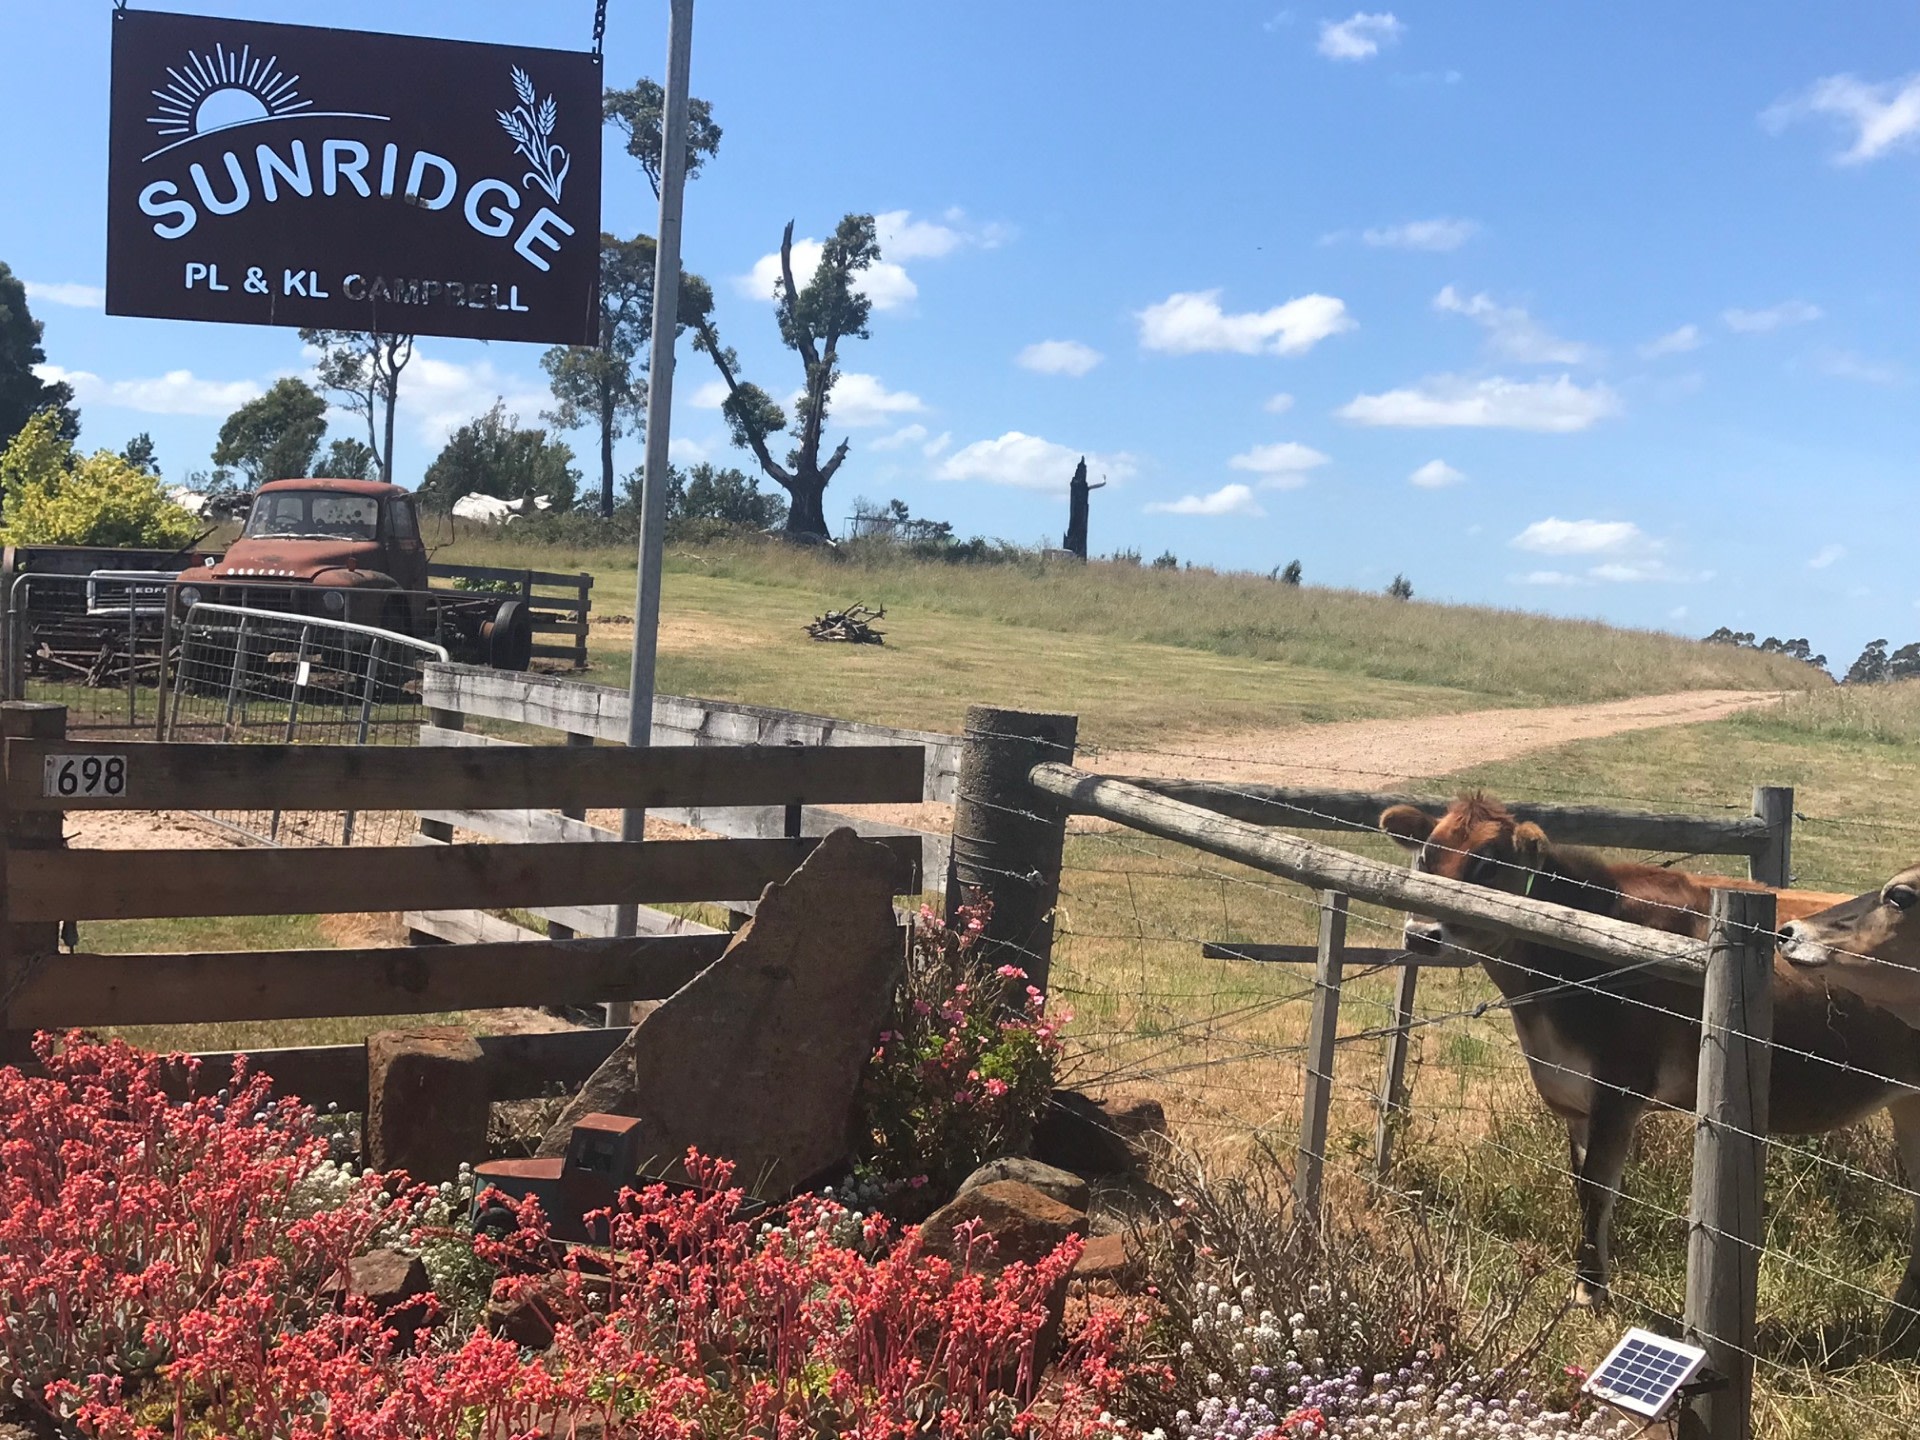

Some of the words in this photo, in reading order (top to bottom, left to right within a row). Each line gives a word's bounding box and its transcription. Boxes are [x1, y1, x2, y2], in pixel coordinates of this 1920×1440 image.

[138, 139, 576, 272] SUNRIDGE
[185, 262, 230, 291] PL
[243, 266, 270, 294] &
[284, 268, 329, 298] KL
[58, 757, 124, 795] 698
